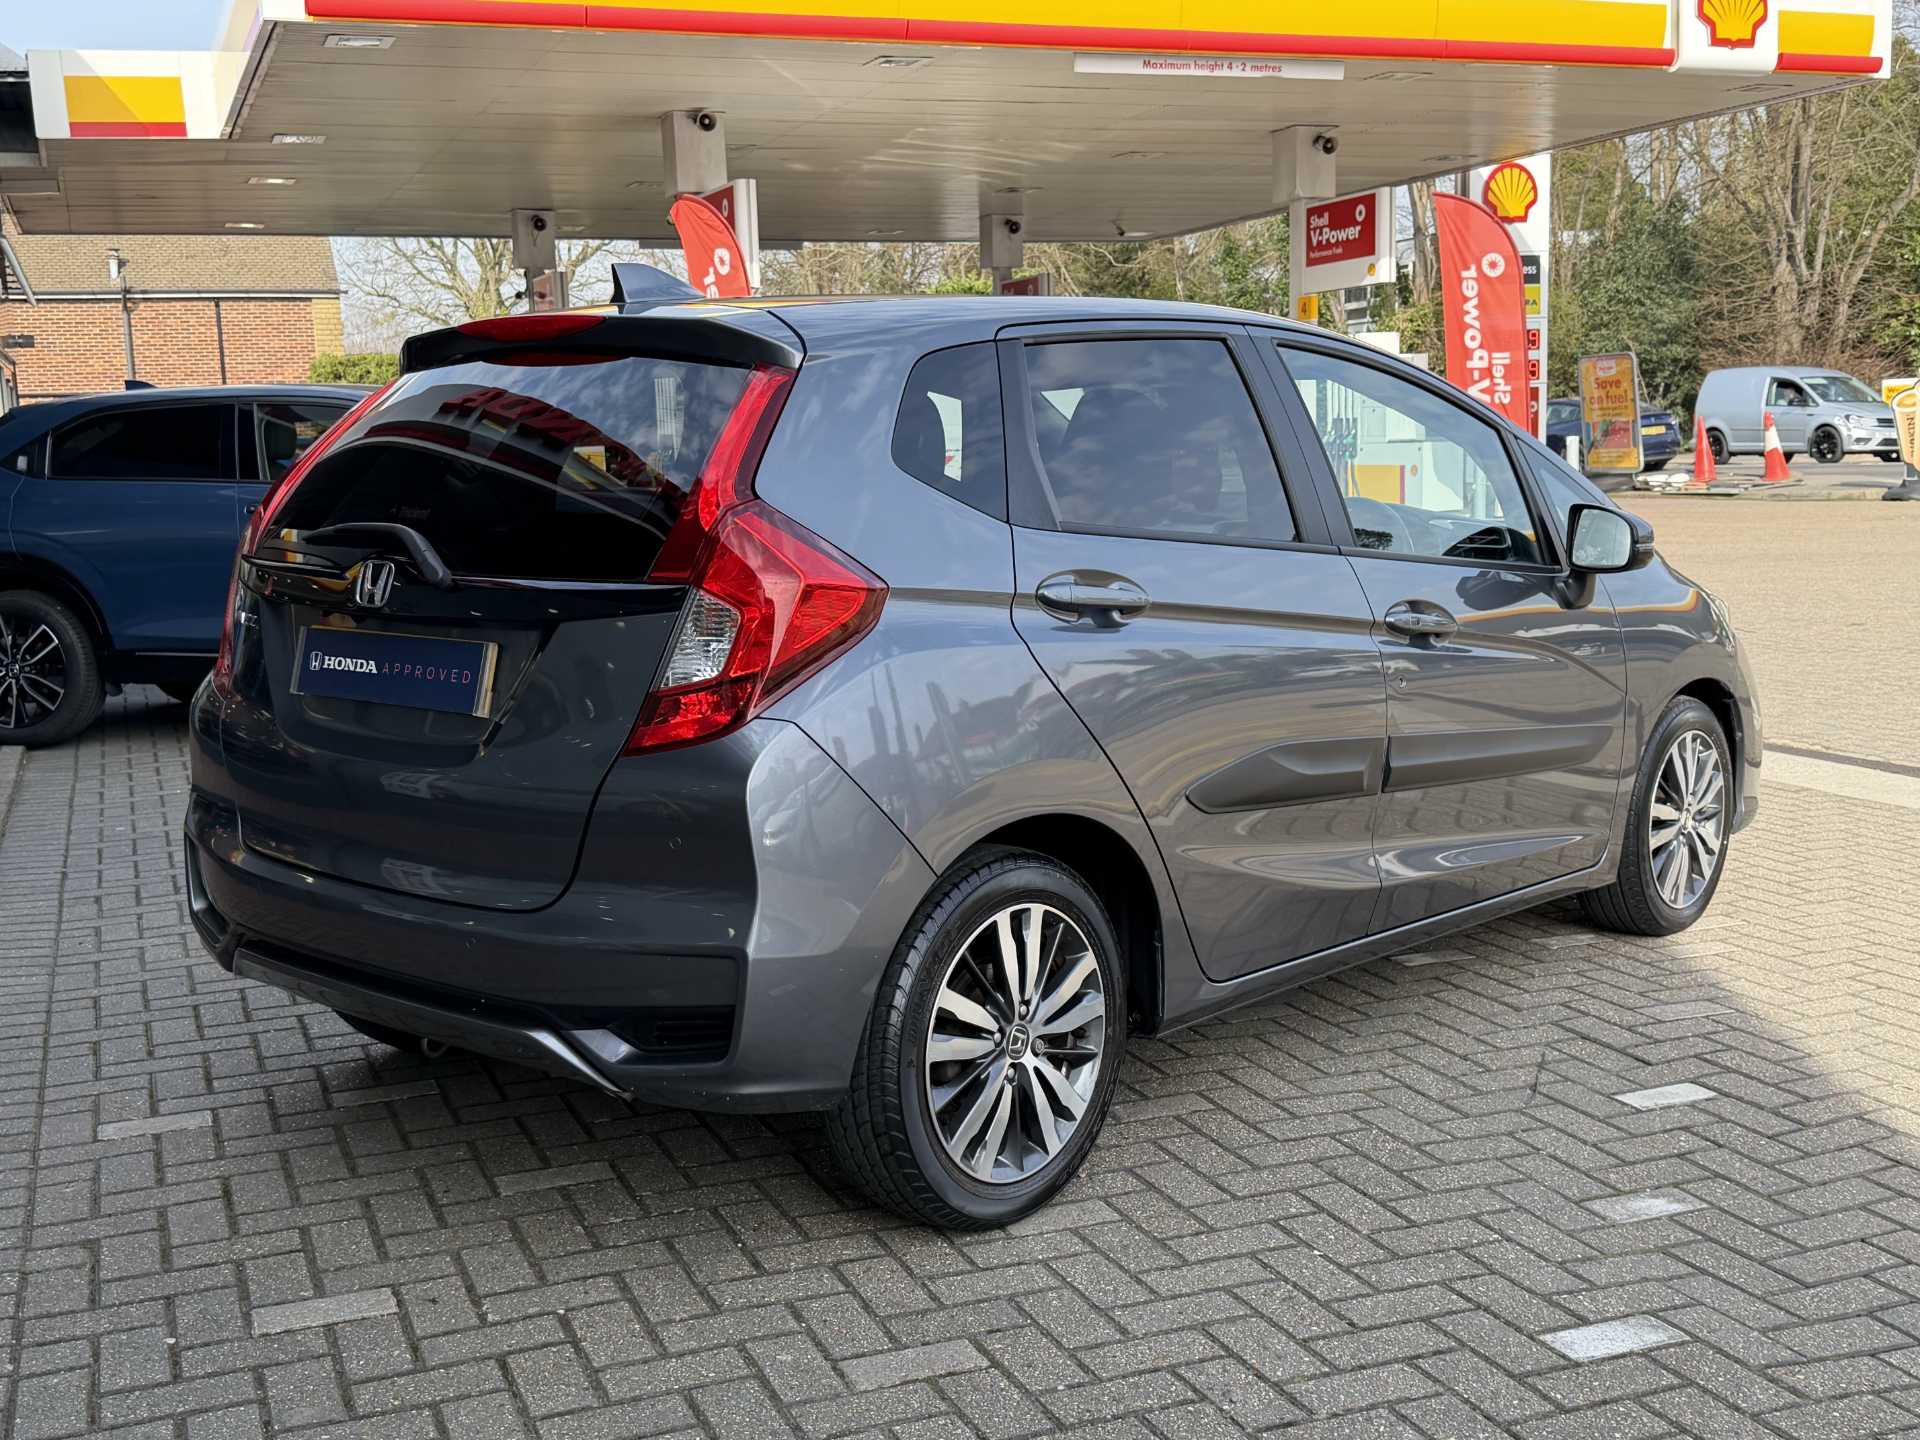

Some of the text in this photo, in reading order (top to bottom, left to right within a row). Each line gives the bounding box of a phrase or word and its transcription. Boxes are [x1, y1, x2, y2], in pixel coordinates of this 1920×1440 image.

[1142, 59, 1191, 71] Maximum
[1193, 60, 1224, 74] height
[1250, 63, 1282, 73] metres
[1309, 212, 1329, 228] Shell
[1310, 224, 1361, 247] V-Power
[1301, 301, 1308, 316] 4
[1594, 377, 1622, 390] Save
[1606, 388, 1628, 404] fuel
[323, 655, 472, 684] HONDA APPROVED
